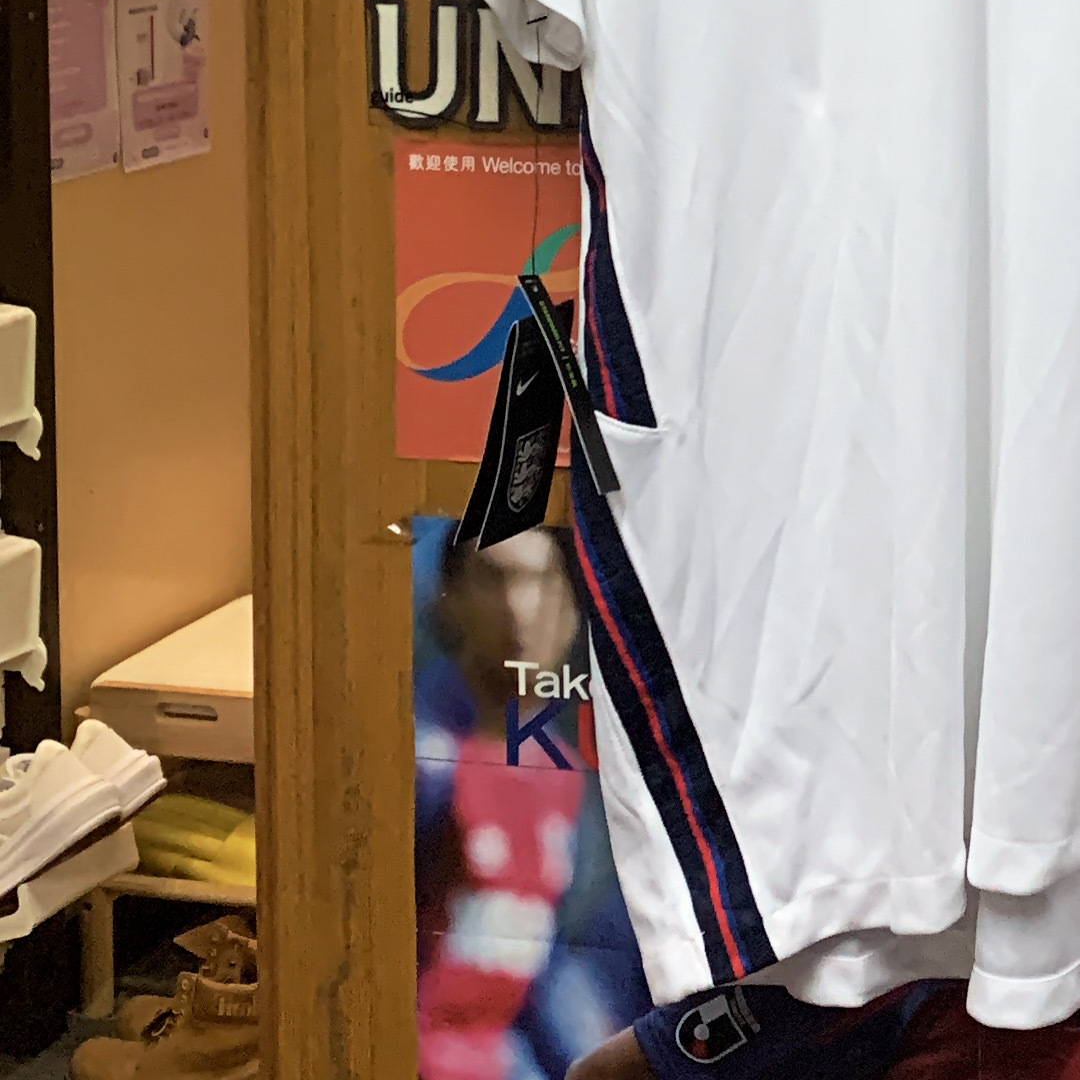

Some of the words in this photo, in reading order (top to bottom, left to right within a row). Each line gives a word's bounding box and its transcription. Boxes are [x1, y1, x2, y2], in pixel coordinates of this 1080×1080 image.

[481, 156, 561, 176] Welcome
[565, 159, 582, 176] to
[503, 660, 592, 700] Tak
